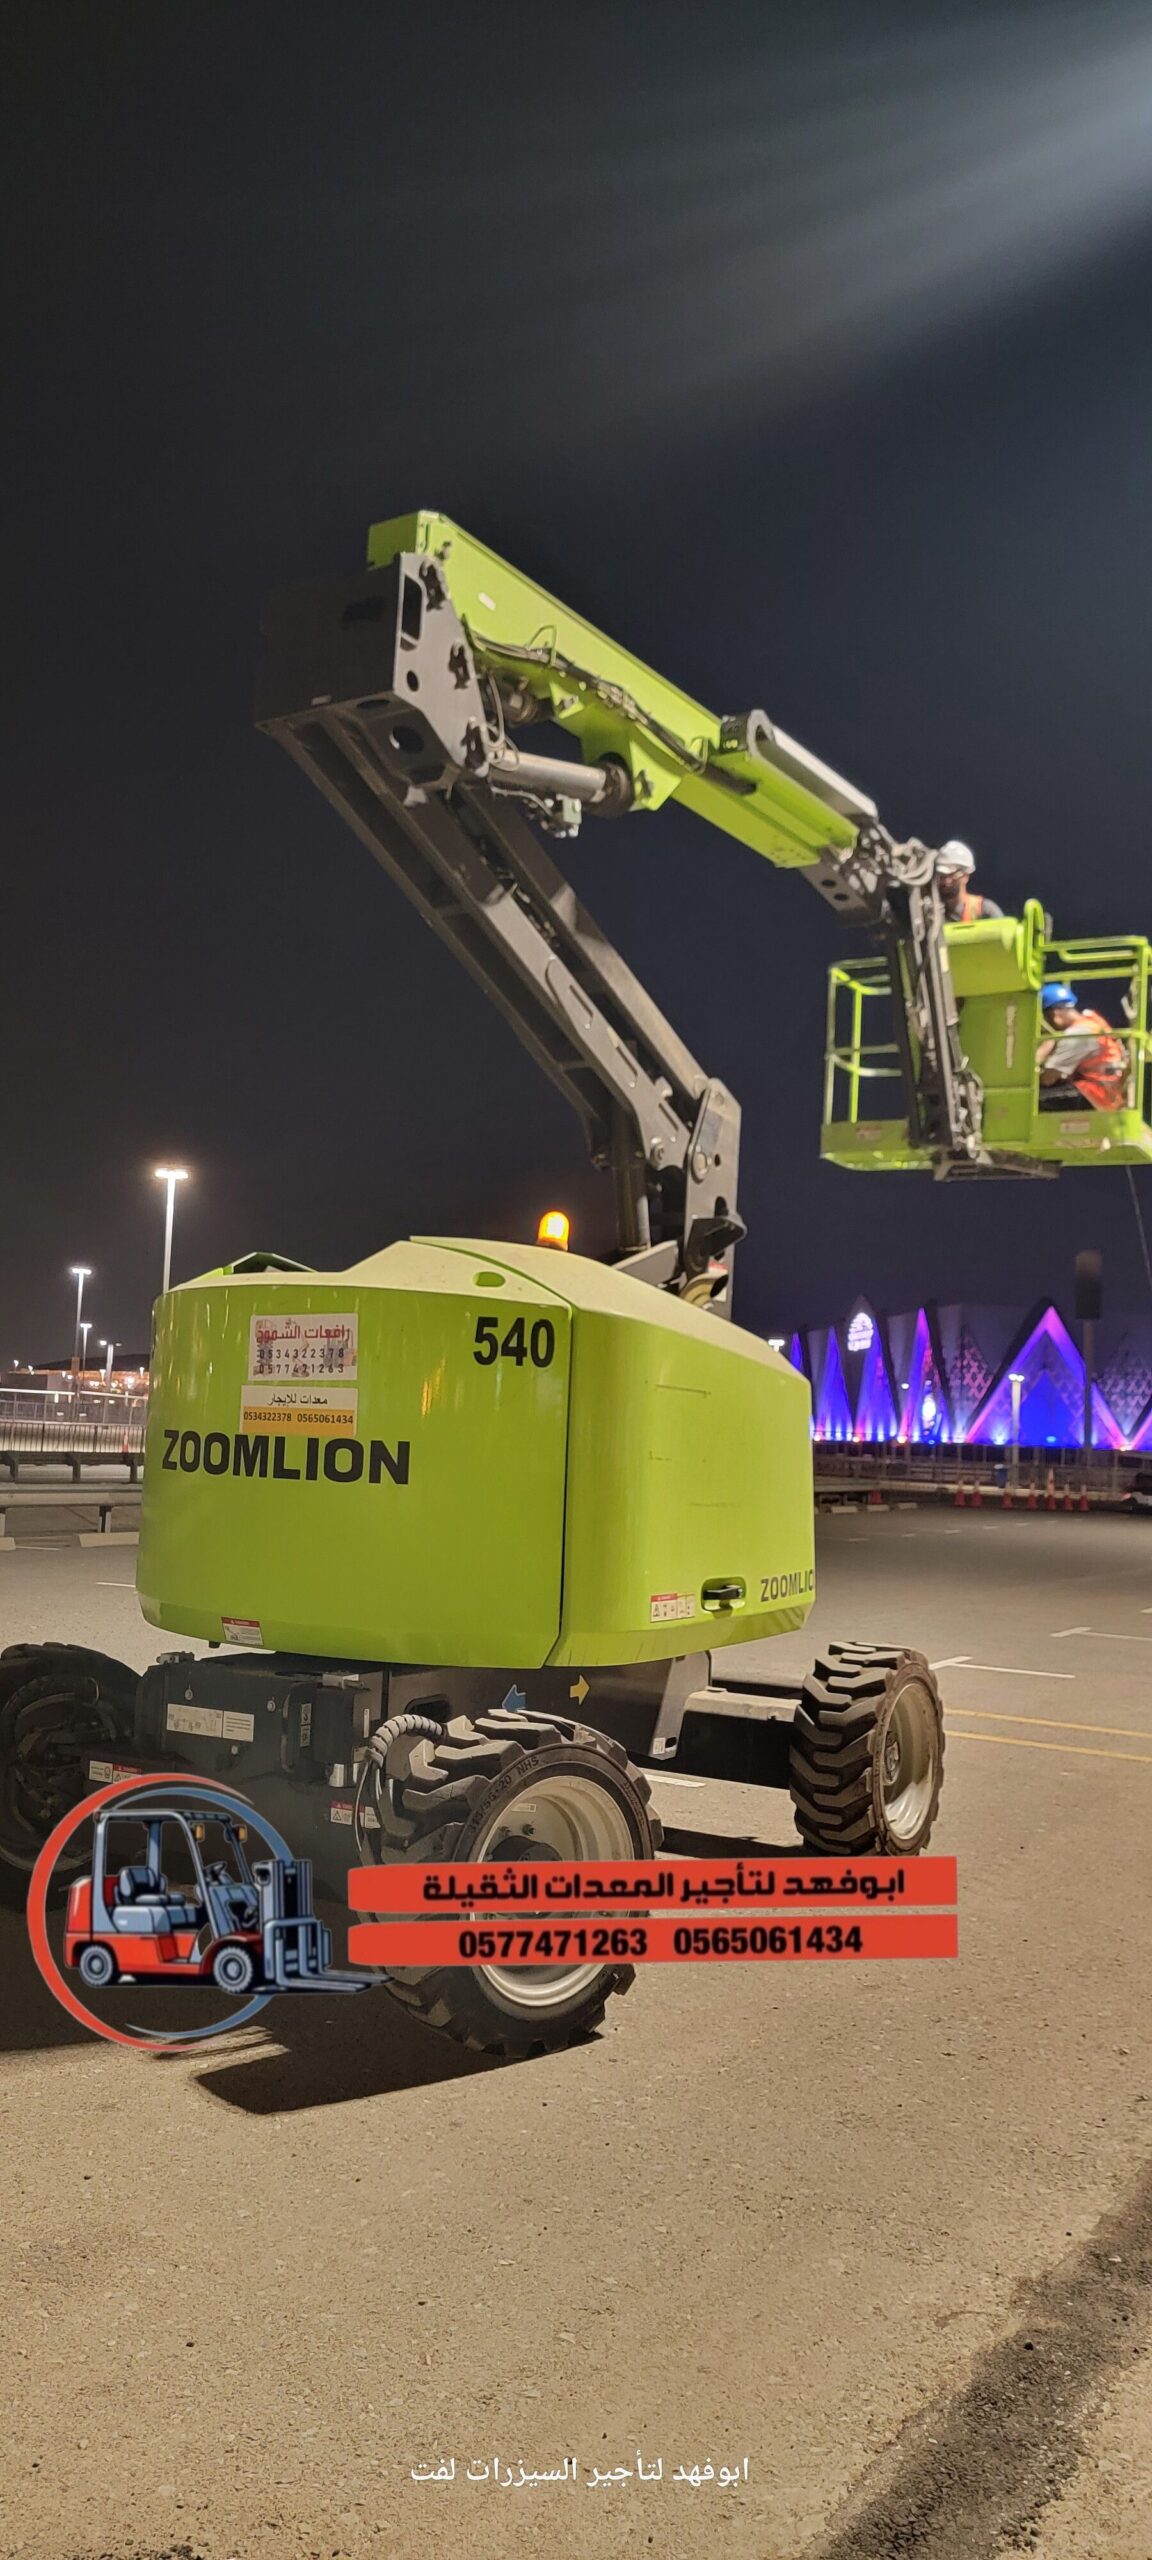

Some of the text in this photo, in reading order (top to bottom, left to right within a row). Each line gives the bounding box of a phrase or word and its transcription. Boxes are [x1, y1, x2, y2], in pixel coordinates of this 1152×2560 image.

[256, 1321, 351, 1343] رافعات الشموخ
[472, 1316, 556, 1368] 540
[300, 1394, 328, 1405] معدات
[243, 1411, 354, 1424] 0534322378 0565061434
[162, 1429, 411, 1485] ZOOMLION
